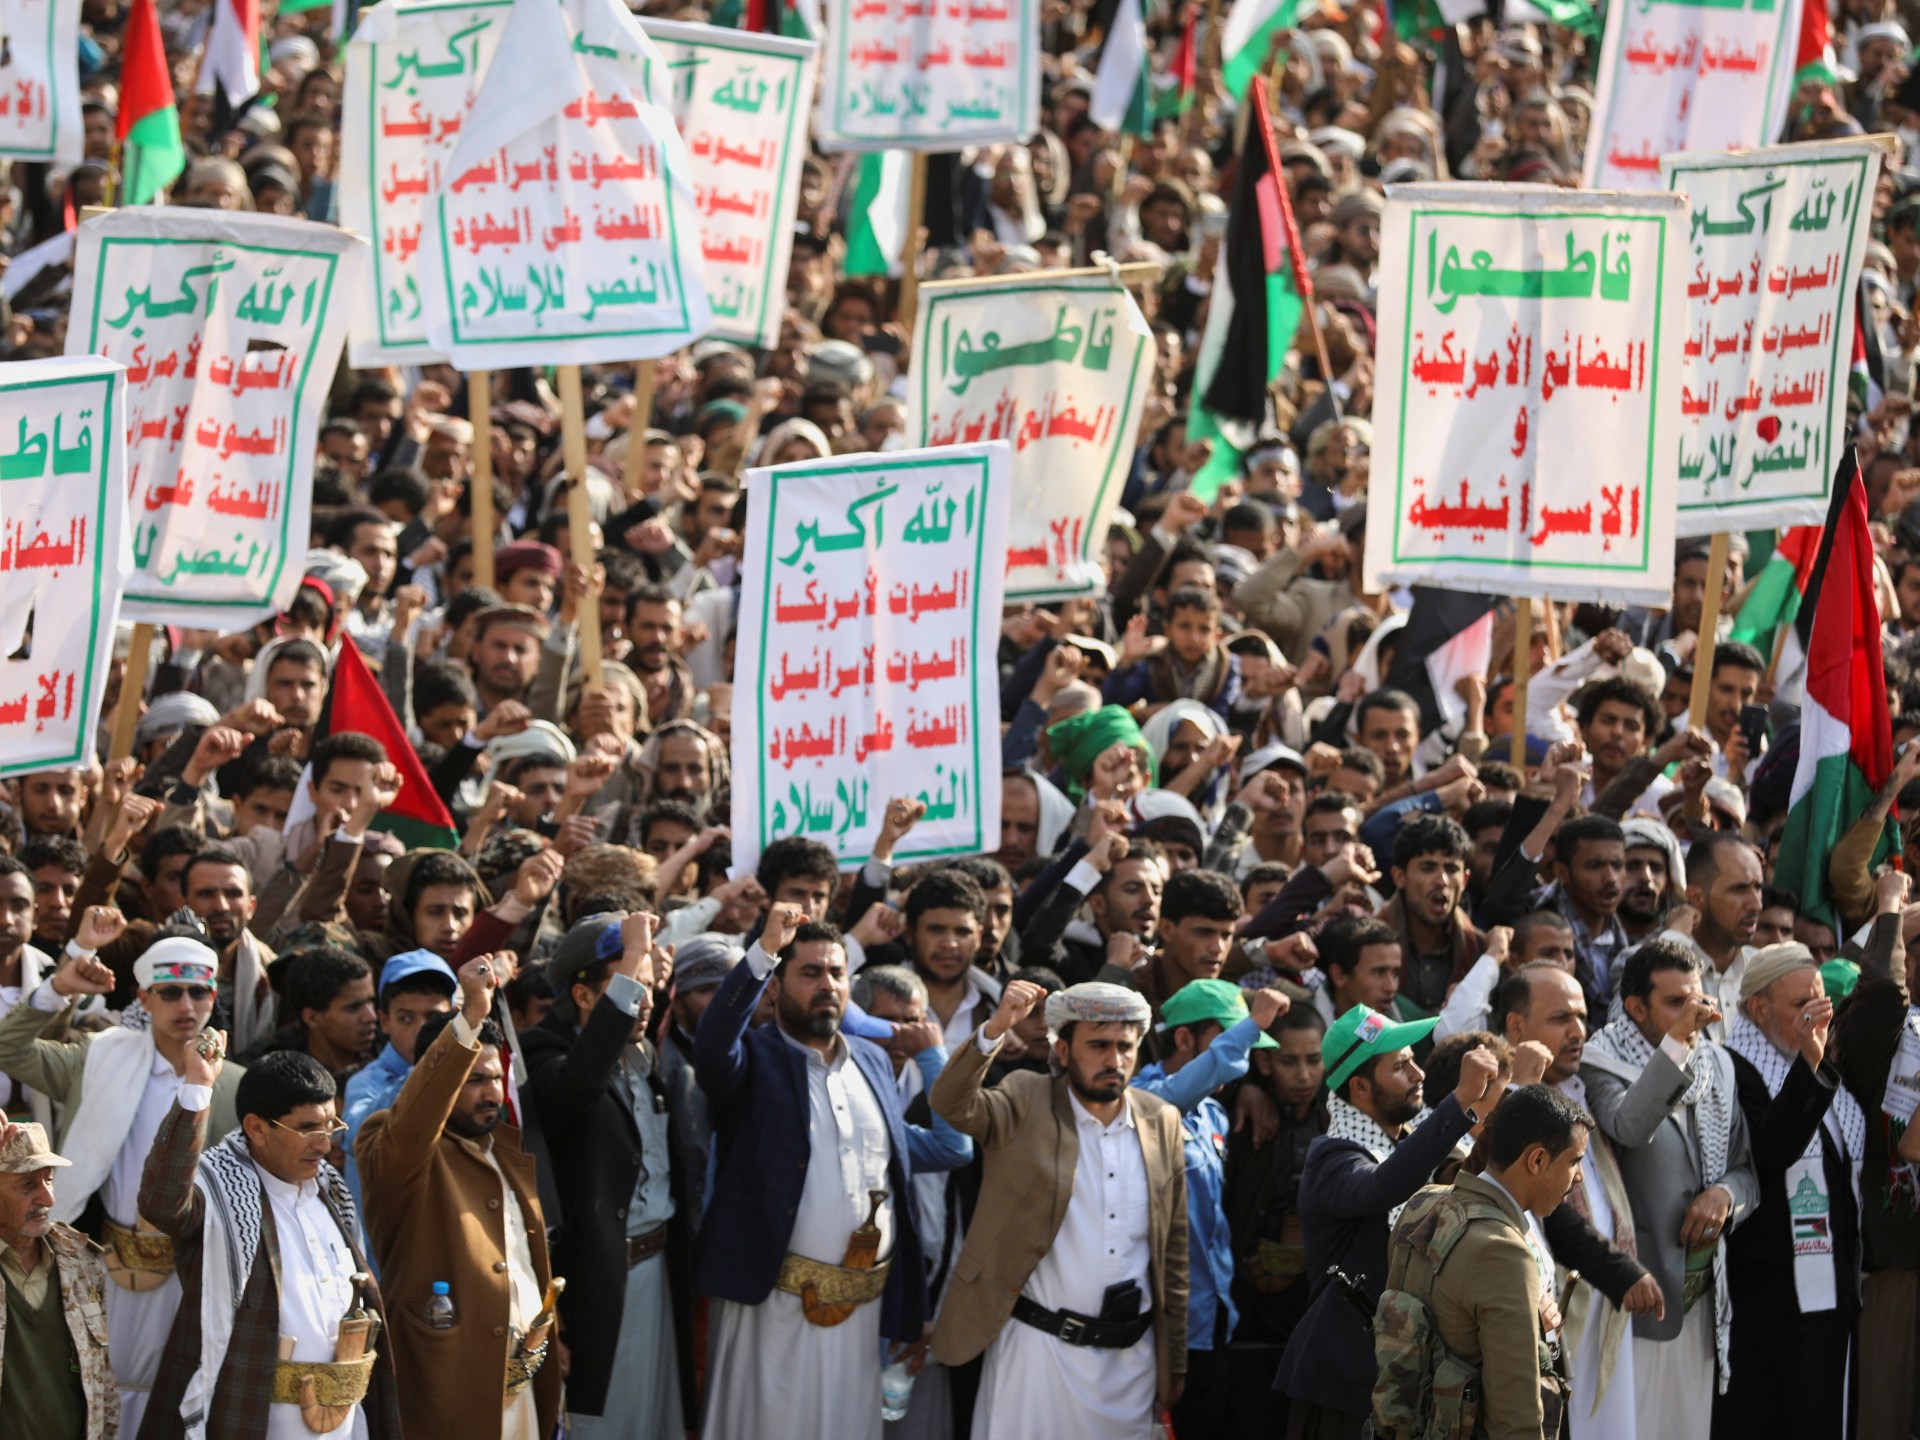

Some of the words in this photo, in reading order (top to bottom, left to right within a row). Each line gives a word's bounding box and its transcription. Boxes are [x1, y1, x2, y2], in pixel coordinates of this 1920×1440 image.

[568, 145, 657, 189] الموت
[453, 206, 531, 254] اليهود
[544, 206, 581, 251] على
[595, 203, 662, 241] اللعنة
[105, 250, 236, 338] أكبر
[235, 267, 318, 326] الله
[461, 262, 565, 328] للإسلام
[580, 256, 671, 321] النصر
[1427, 227, 1632, 314] قاطعوا
[1687, 250, 1761, 304] لأمريك
[1768, 253, 1840, 299] الموت
[941, 304, 1117, 396] قاطعوا
[1684, 317, 1754, 364] لإسرائي
[1762, 311, 1831, 358] الموت
[1542, 330, 1645, 402] البضائع
[1769, 369, 1825, 407] اللعنة
[1681, 378, 1719, 424] اليه
[1725, 377, 1764, 421] على
[0, 412, 92, 481] قاط
[195, 416, 287, 459] الموت
[1511, 405, 1529, 458] و
[1740, 422, 1820, 489] النصر
[145, 468, 194, 511] على
[206, 472, 279, 521] اللعنة
[904, 481, 975, 544] الله
[1408, 474, 1640, 551] الإسرائيلية
[0, 514, 86, 578] البضائ
[777, 476, 898, 575] أكبر
[160, 532, 271, 585] النصر
[775, 564, 878, 630] لأمريكا
[889, 567, 968, 623] الموت
[770, 641, 876, 700] لإسرائيل
[886, 636, 965, 692] الموت
[769, 714, 846, 770] اليهود
[855, 713, 893, 764] على
[906, 703, 966, 749] اللعنة
[772, 776, 868, 850] للإسلام
